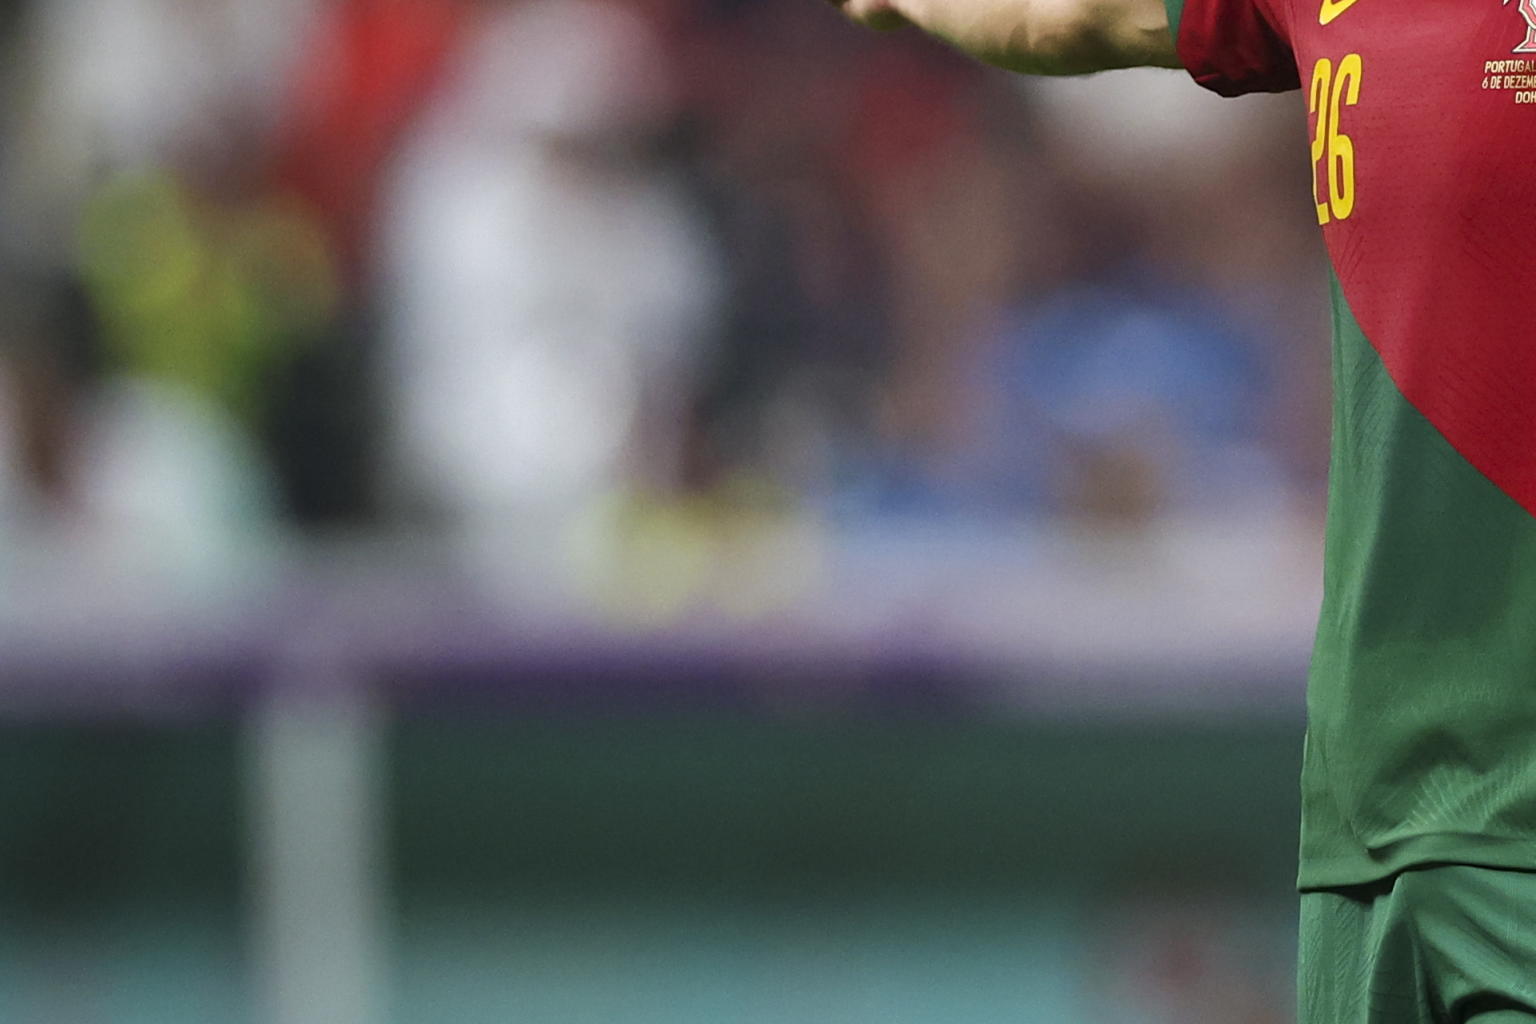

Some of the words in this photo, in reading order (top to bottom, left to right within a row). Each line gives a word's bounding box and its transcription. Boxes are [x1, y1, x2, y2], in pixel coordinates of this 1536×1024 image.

[1484, 59, 1536, 74] PORTUGAL
[1481, 77, 1489, 90] 6
[1490, 75, 1503, 89] DE
[1310, 53, 1362, 226] 26
